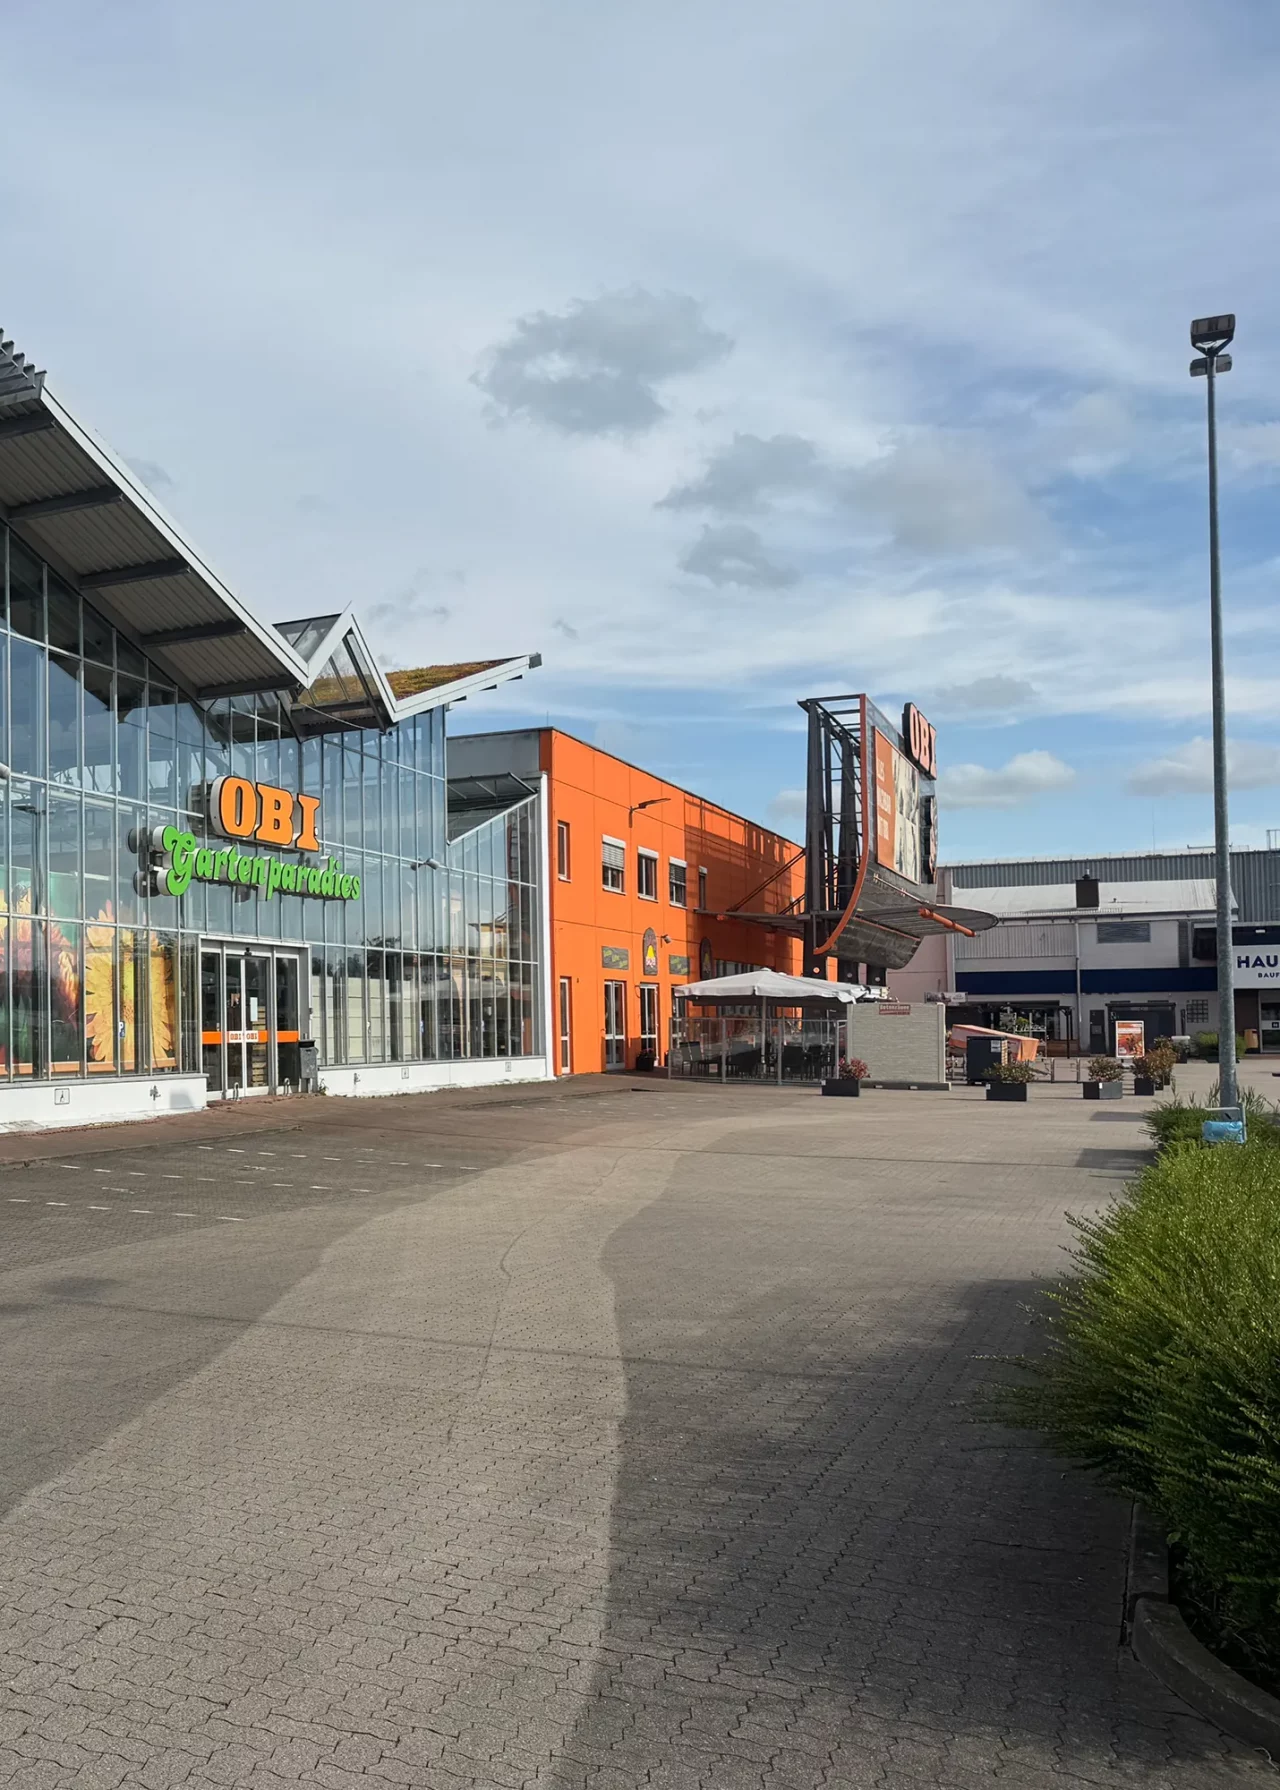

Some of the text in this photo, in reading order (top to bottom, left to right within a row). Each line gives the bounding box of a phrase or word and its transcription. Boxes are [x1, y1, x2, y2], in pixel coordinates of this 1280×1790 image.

[909, 703, 937, 779] OBI
[220, 775, 320, 852] OBI
[161, 825, 361, 901] Gartenparadies
[1237, 955, 1279, 968] HAU
